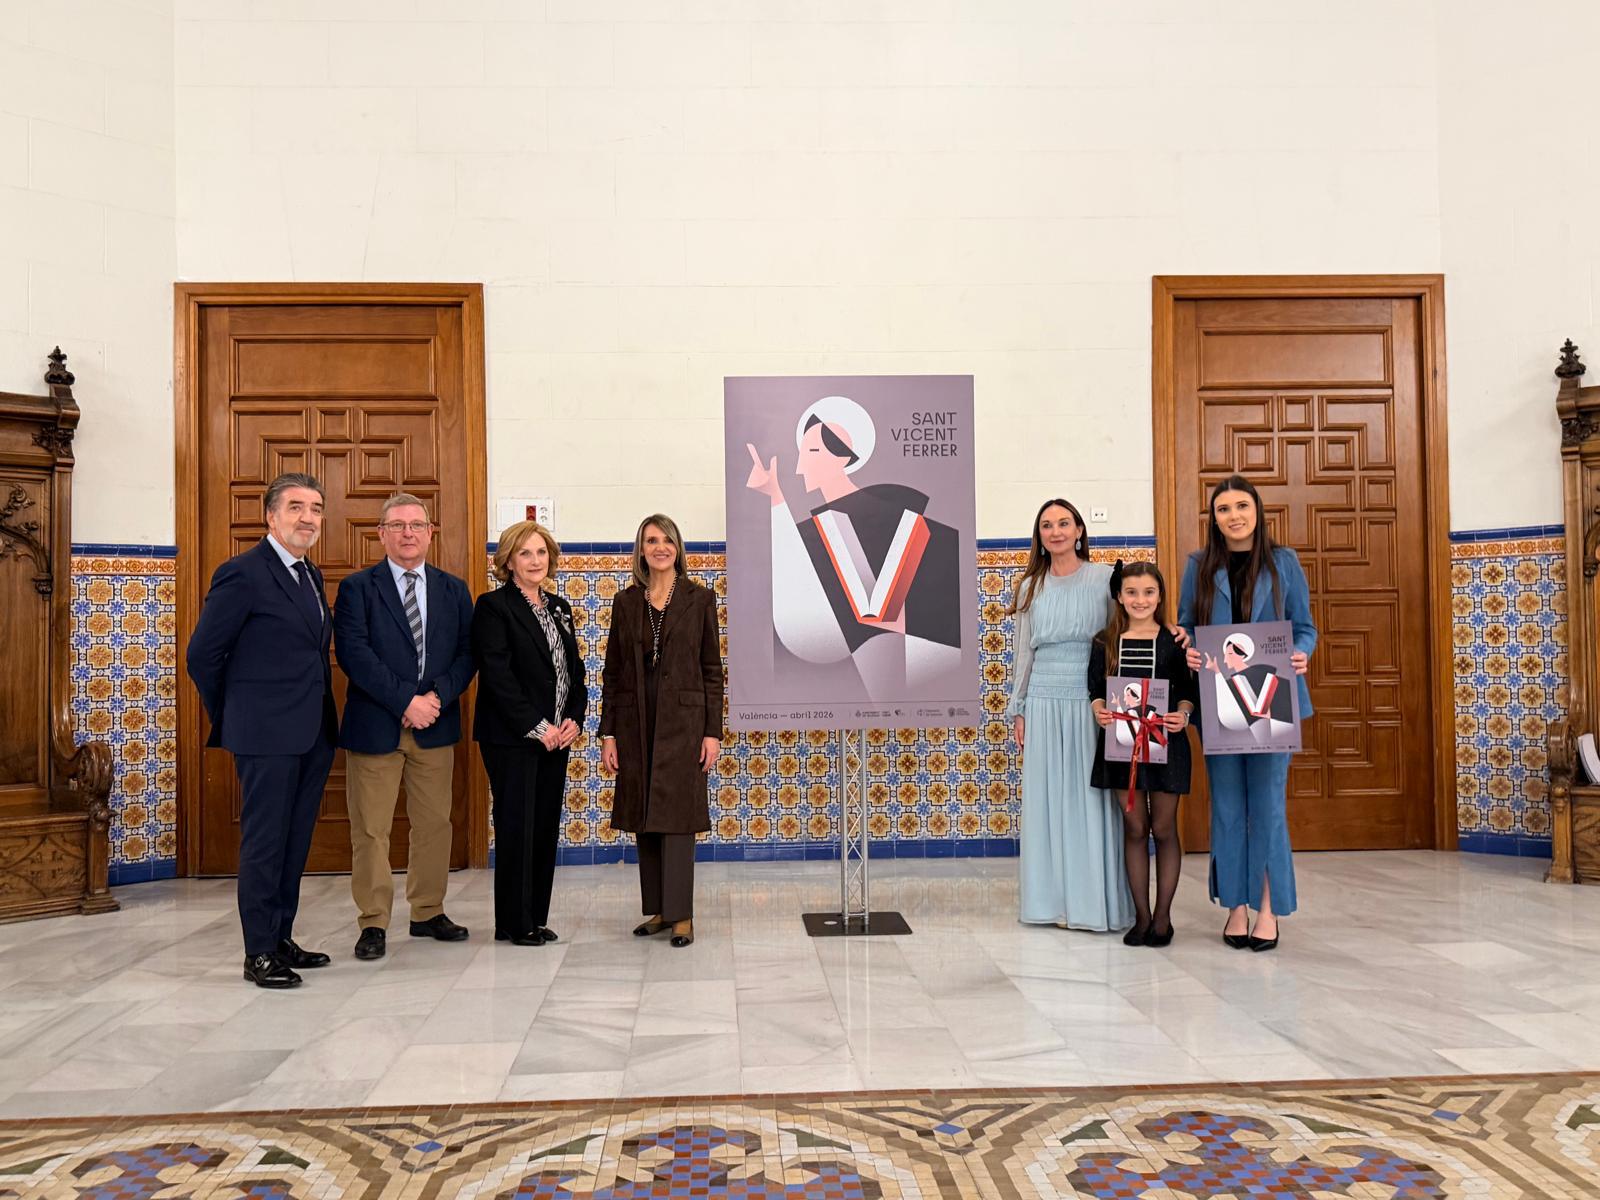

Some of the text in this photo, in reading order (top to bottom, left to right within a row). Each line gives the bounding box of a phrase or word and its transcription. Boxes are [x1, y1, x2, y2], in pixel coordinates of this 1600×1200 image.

[912, 412, 957, 425] SANT
[891, 428, 957, 441] VICENT
[903, 444, 957, 457] FERRER
[739, 711, 778, 720] València
[790, 711, 811, 719] abril
[813, 711, 834, 719] 2026
